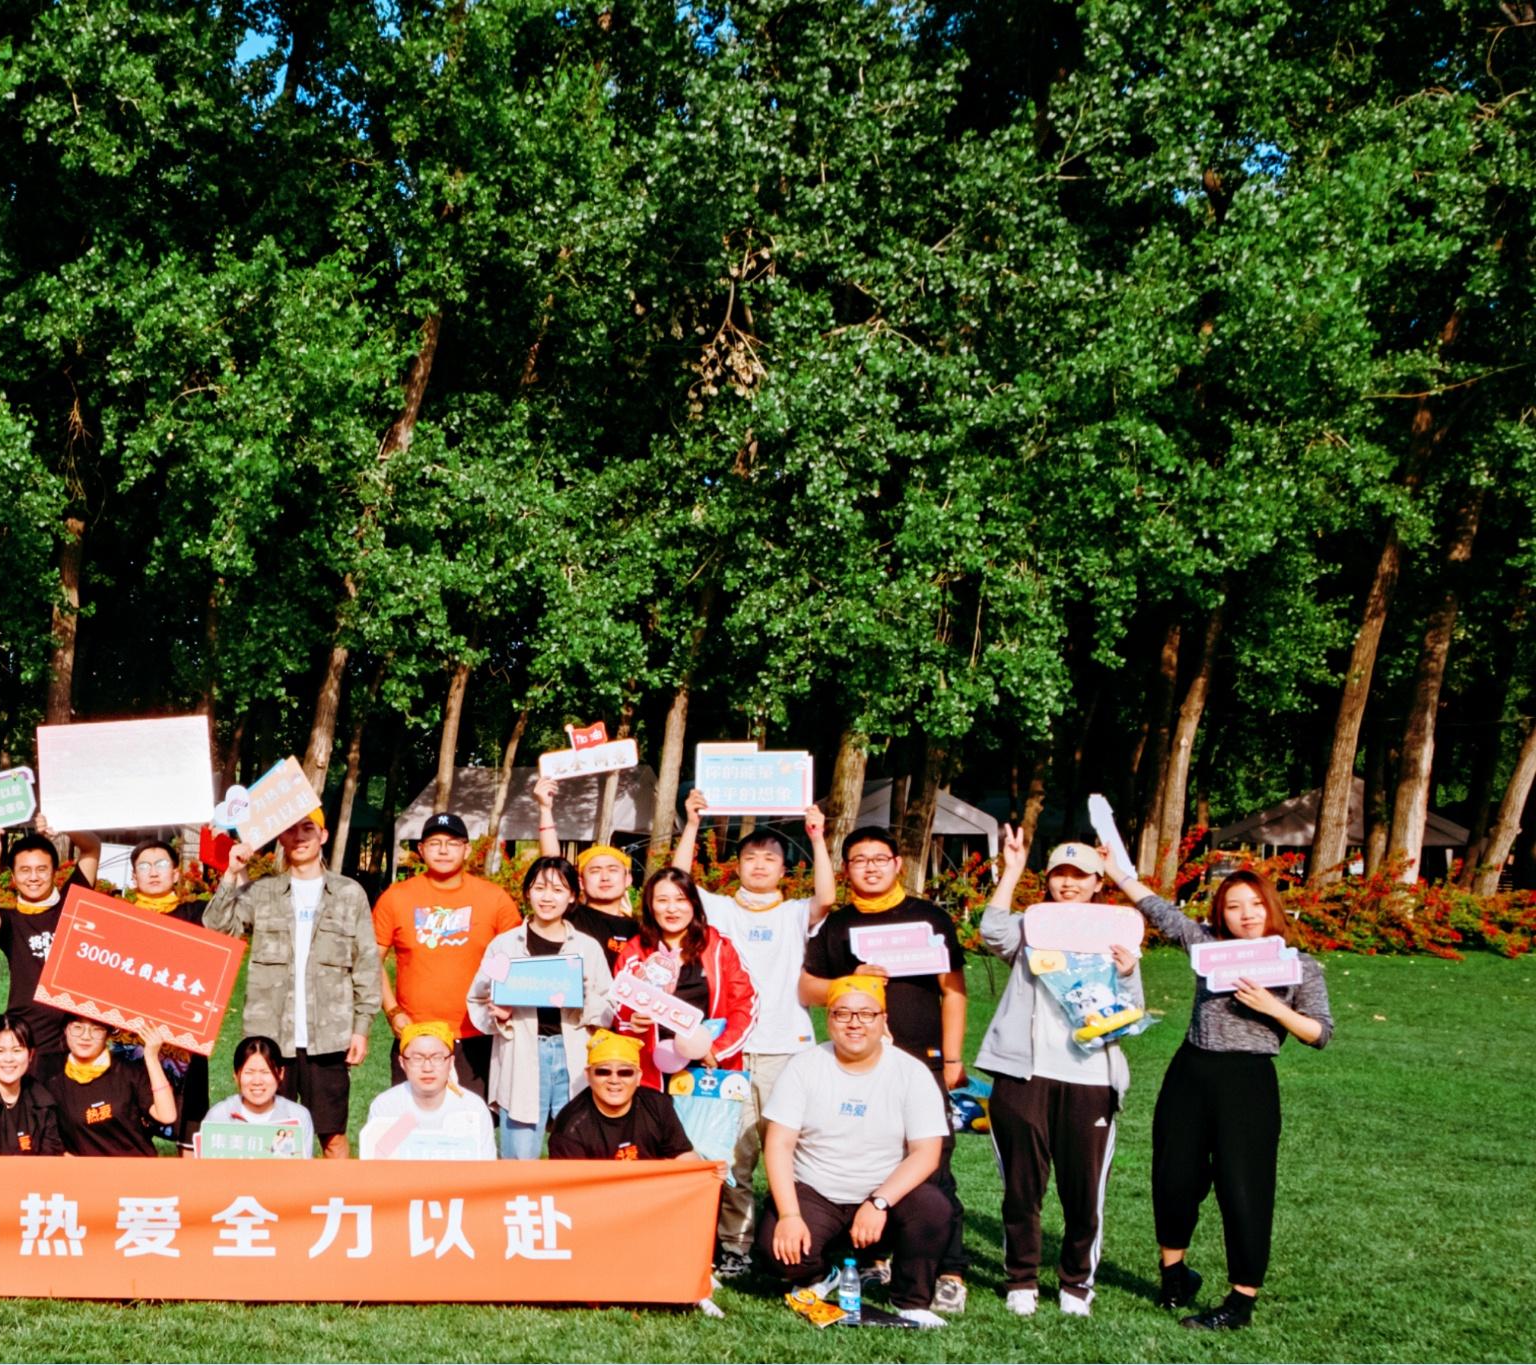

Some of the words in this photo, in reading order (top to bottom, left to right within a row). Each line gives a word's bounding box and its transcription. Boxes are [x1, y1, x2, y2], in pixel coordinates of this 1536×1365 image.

[76, 941, 206, 997] 3000元团建基金
[86, 1106, 112, 1124] 热爱
[839, 1101, 867, 1117] 热爱
